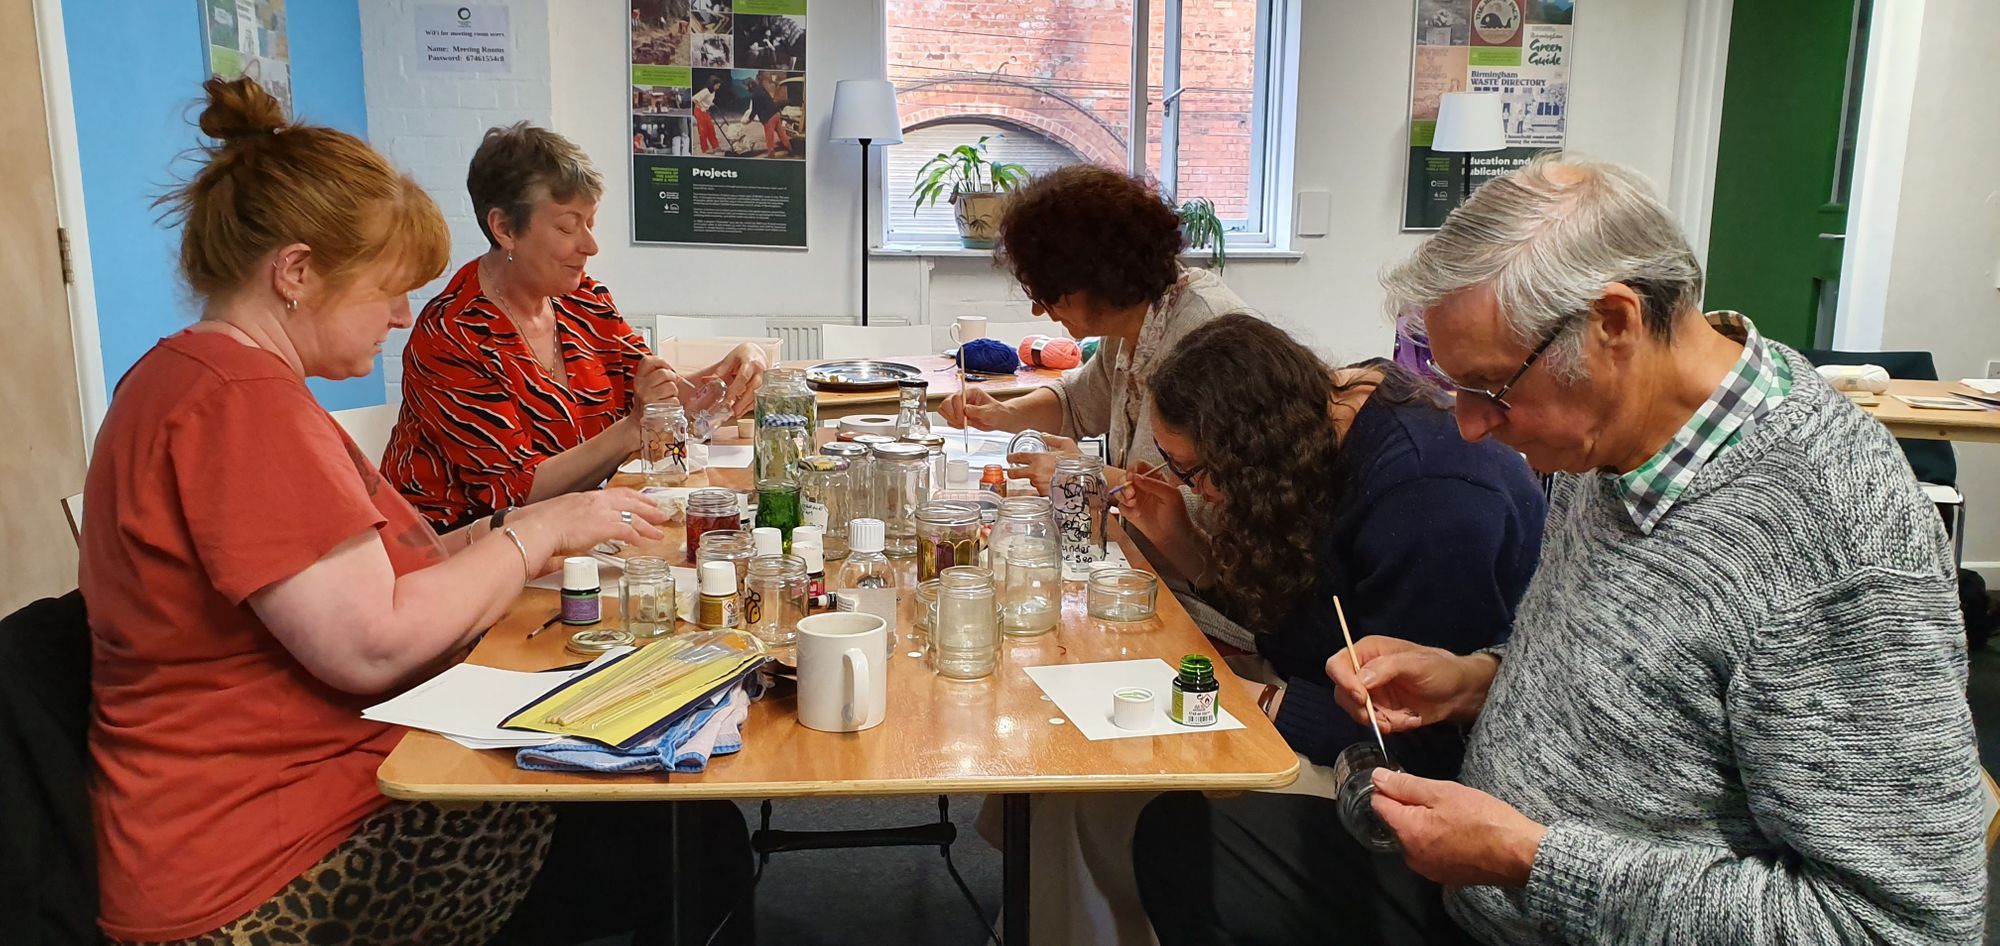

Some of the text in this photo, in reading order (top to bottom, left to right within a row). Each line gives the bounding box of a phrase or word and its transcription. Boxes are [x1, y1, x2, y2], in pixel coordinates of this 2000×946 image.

[427, 45, 449, 53] Name:
[453, 46, 480, 54] Meeting
[1529, 39, 1562, 52] Green
[428, 54, 462, 62] Password:
[1528, 52, 1562, 66] Guide
[1471, 70, 1519, 79] Birmingham
[1470, 78, 1547, 87] WASTE DIRECTORY
[1512, 157, 1531, 166] and
[692, 167, 738, 179] Projects
